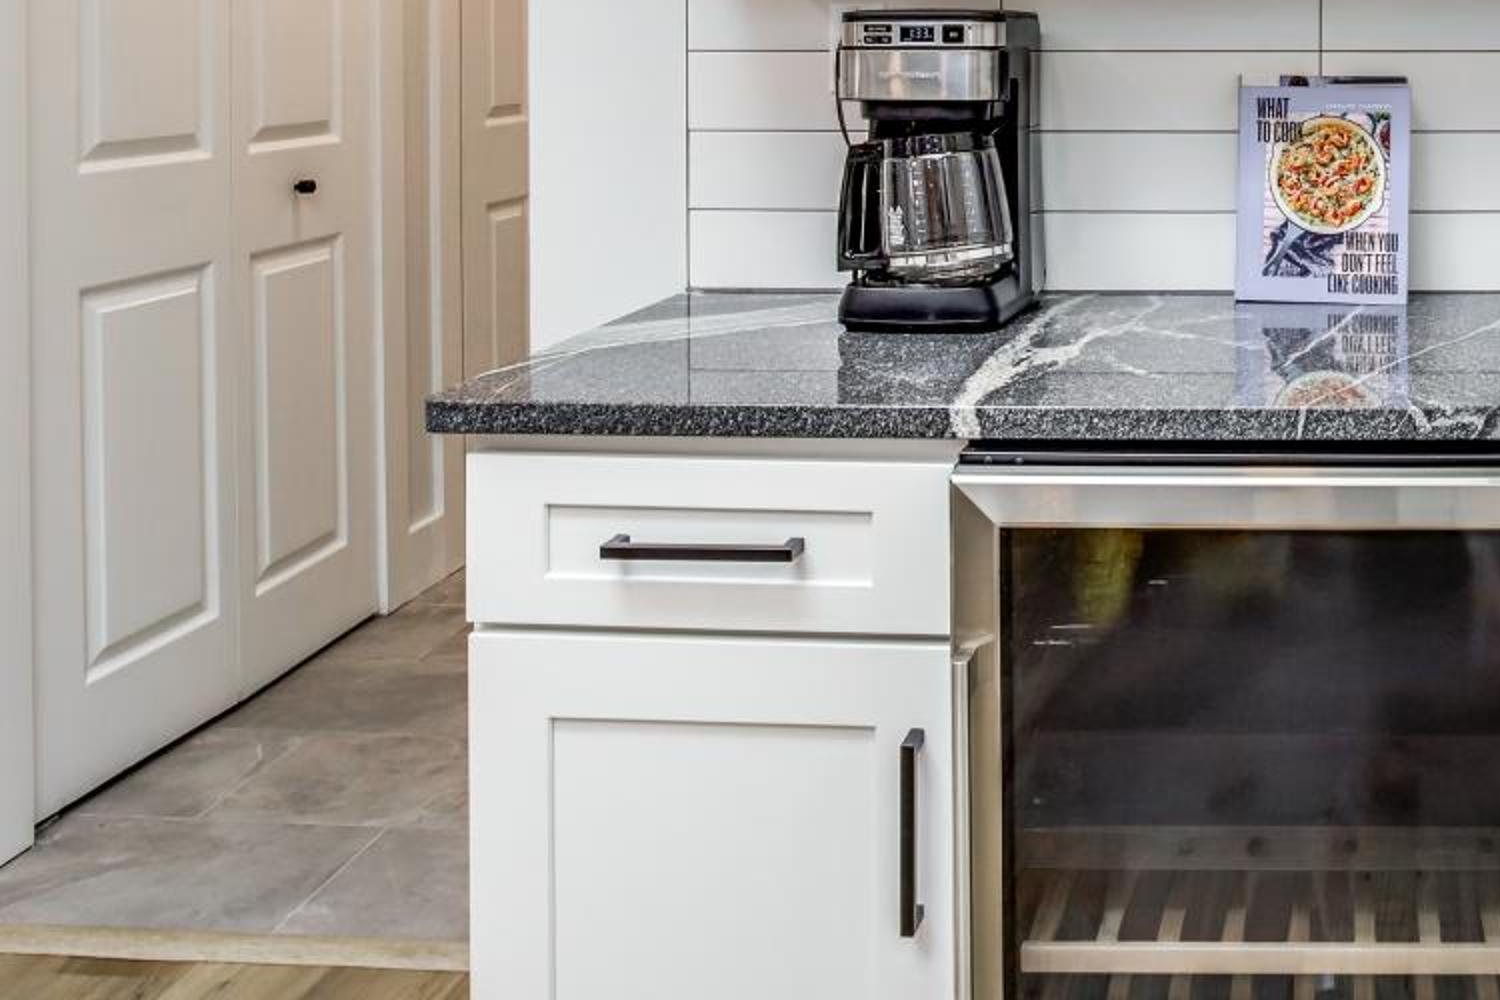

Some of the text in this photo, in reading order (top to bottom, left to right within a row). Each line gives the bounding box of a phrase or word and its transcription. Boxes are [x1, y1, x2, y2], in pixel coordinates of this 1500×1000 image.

[1257, 97, 1290, 118] WHAT
[1256, 120, 1303, 142] TO COOK
[1345, 231, 1398, 252] WHEN YOU
[1342, 253, 1398, 273] DON'T FEEL
[1328, 274, 1398, 295] LIKE COOKING
